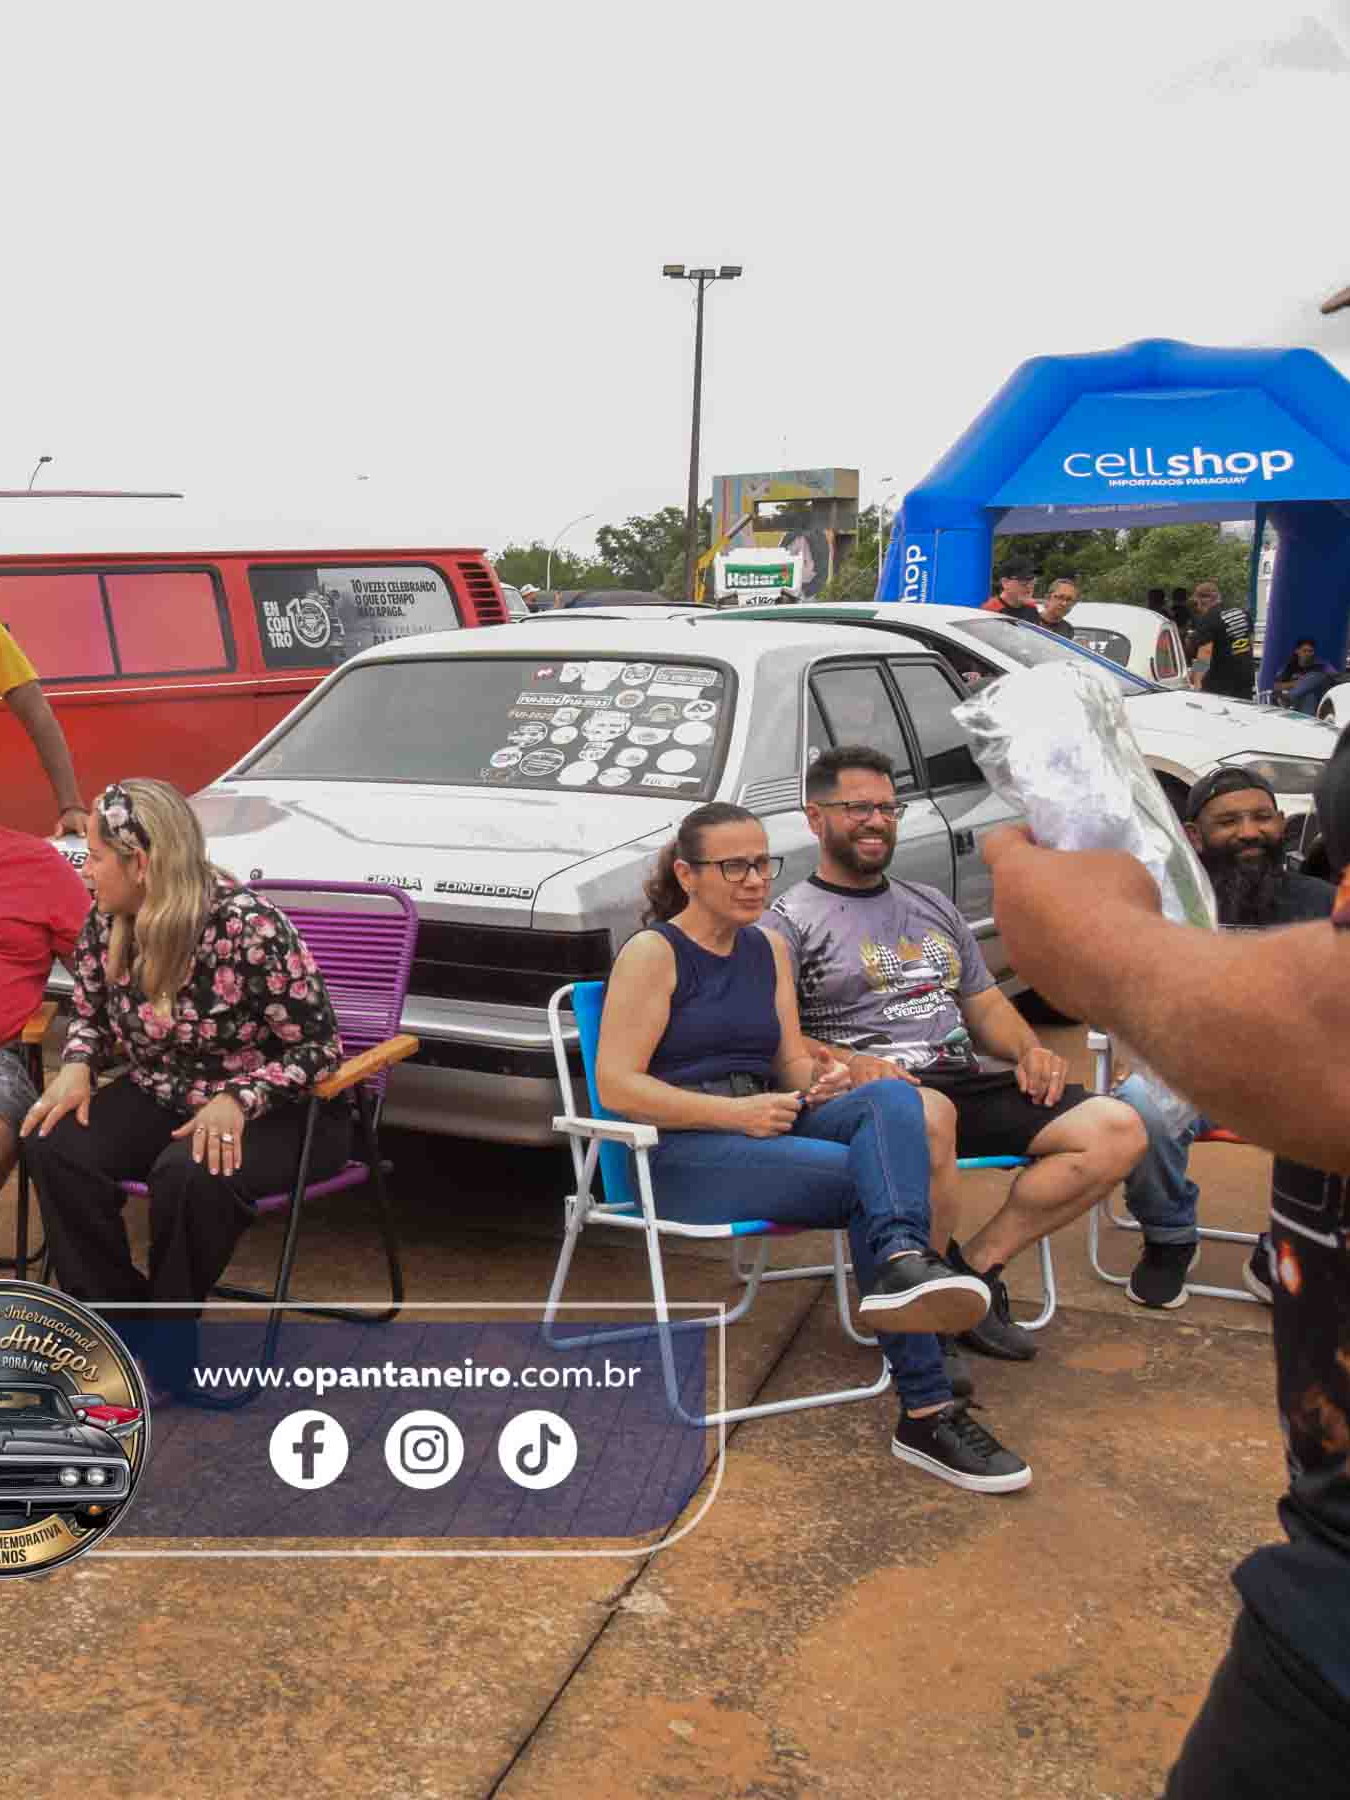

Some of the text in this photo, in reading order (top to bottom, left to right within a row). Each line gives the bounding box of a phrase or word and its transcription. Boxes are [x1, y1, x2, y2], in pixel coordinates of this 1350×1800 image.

[1062, 446, 1294, 481] cellshop
[1108, 476, 1247, 488] IMPORTADOS PARAGUAY
[363, 581, 387, 593] VEZES
[388, 580, 437, 593] CELEBRANDO
[363, 593, 379, 606] QUE
[387, 593, 415, 605] TEMPO
[266, 616, 291, 633] CON
[268, 632, 293, 648] TRO
[433, 881, 534, 899] COMODORO
